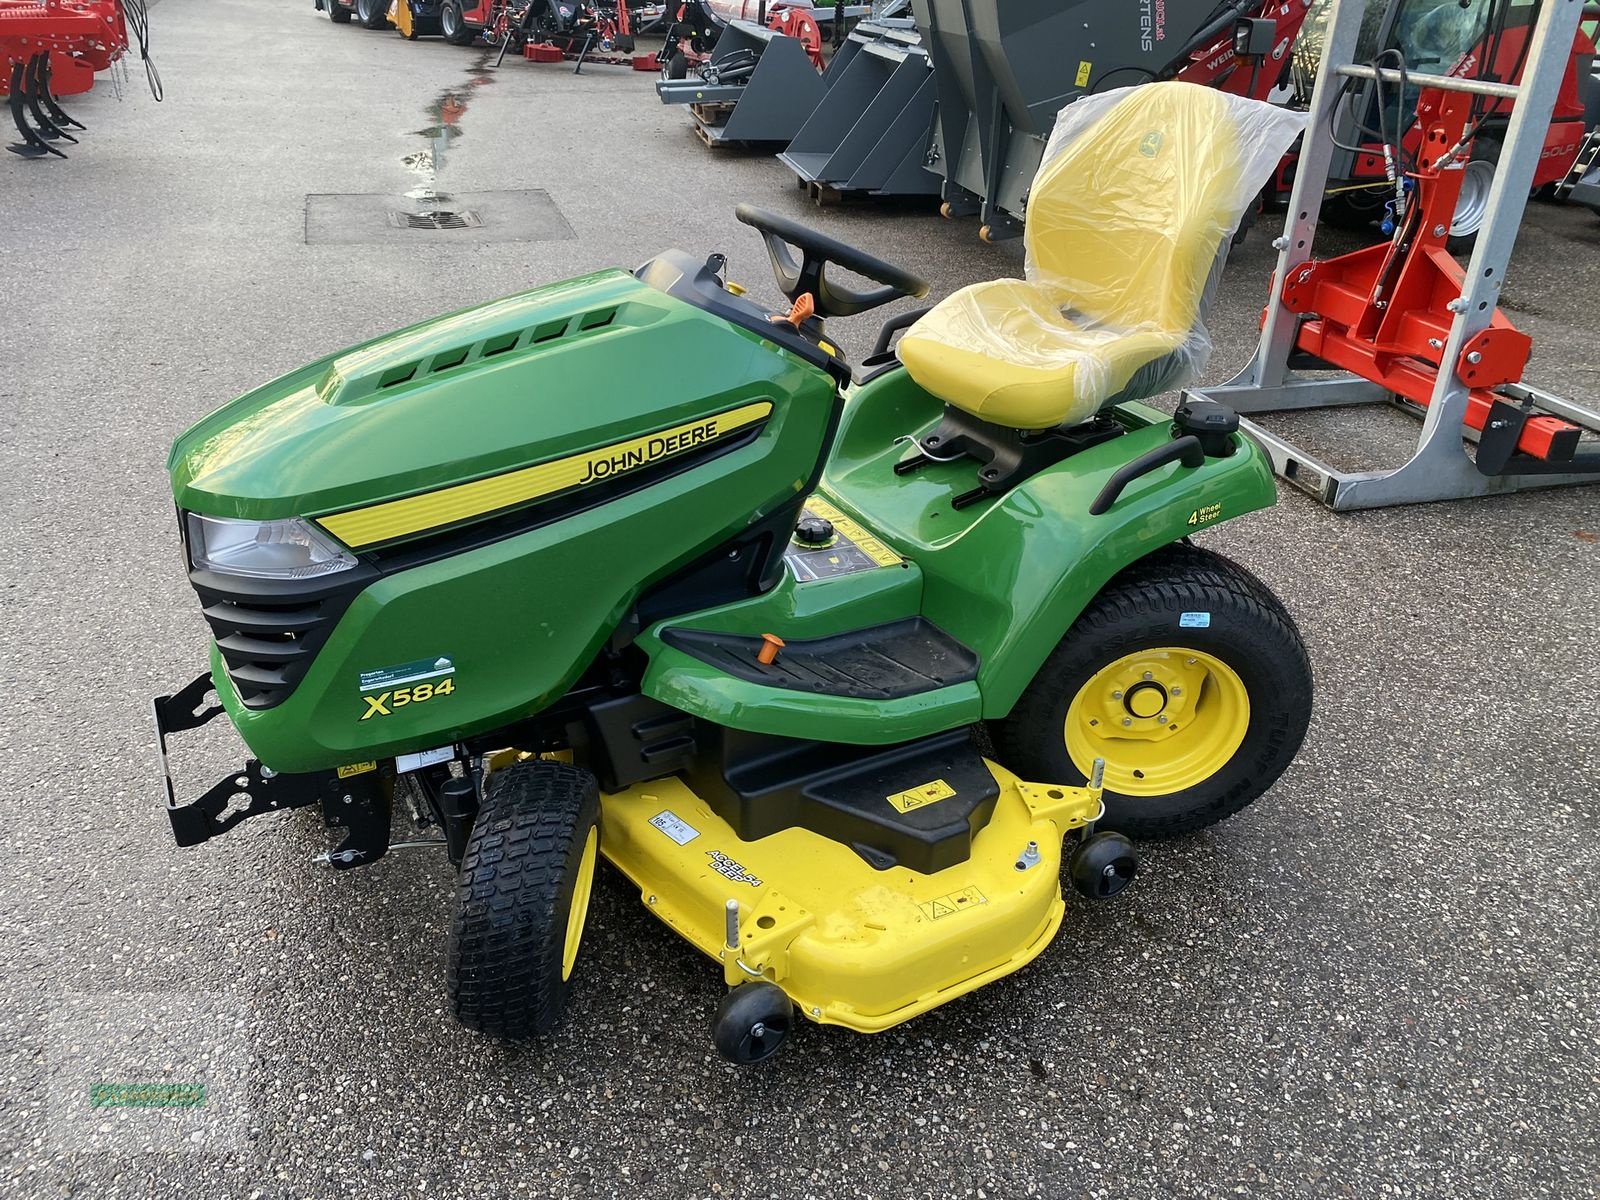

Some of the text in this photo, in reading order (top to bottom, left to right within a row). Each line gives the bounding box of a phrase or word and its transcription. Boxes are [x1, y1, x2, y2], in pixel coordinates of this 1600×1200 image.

[579, 420, 718, 484] JOHN DEERE
[1187, 501, 1221, 525] 4 Wheel
[1199, 510, 1221, 524] Steer
[359, 677, 456, 721] X584
[705, 850, 764, 887] ACCEL 54
[707, 860, 744, 883] DEEP
